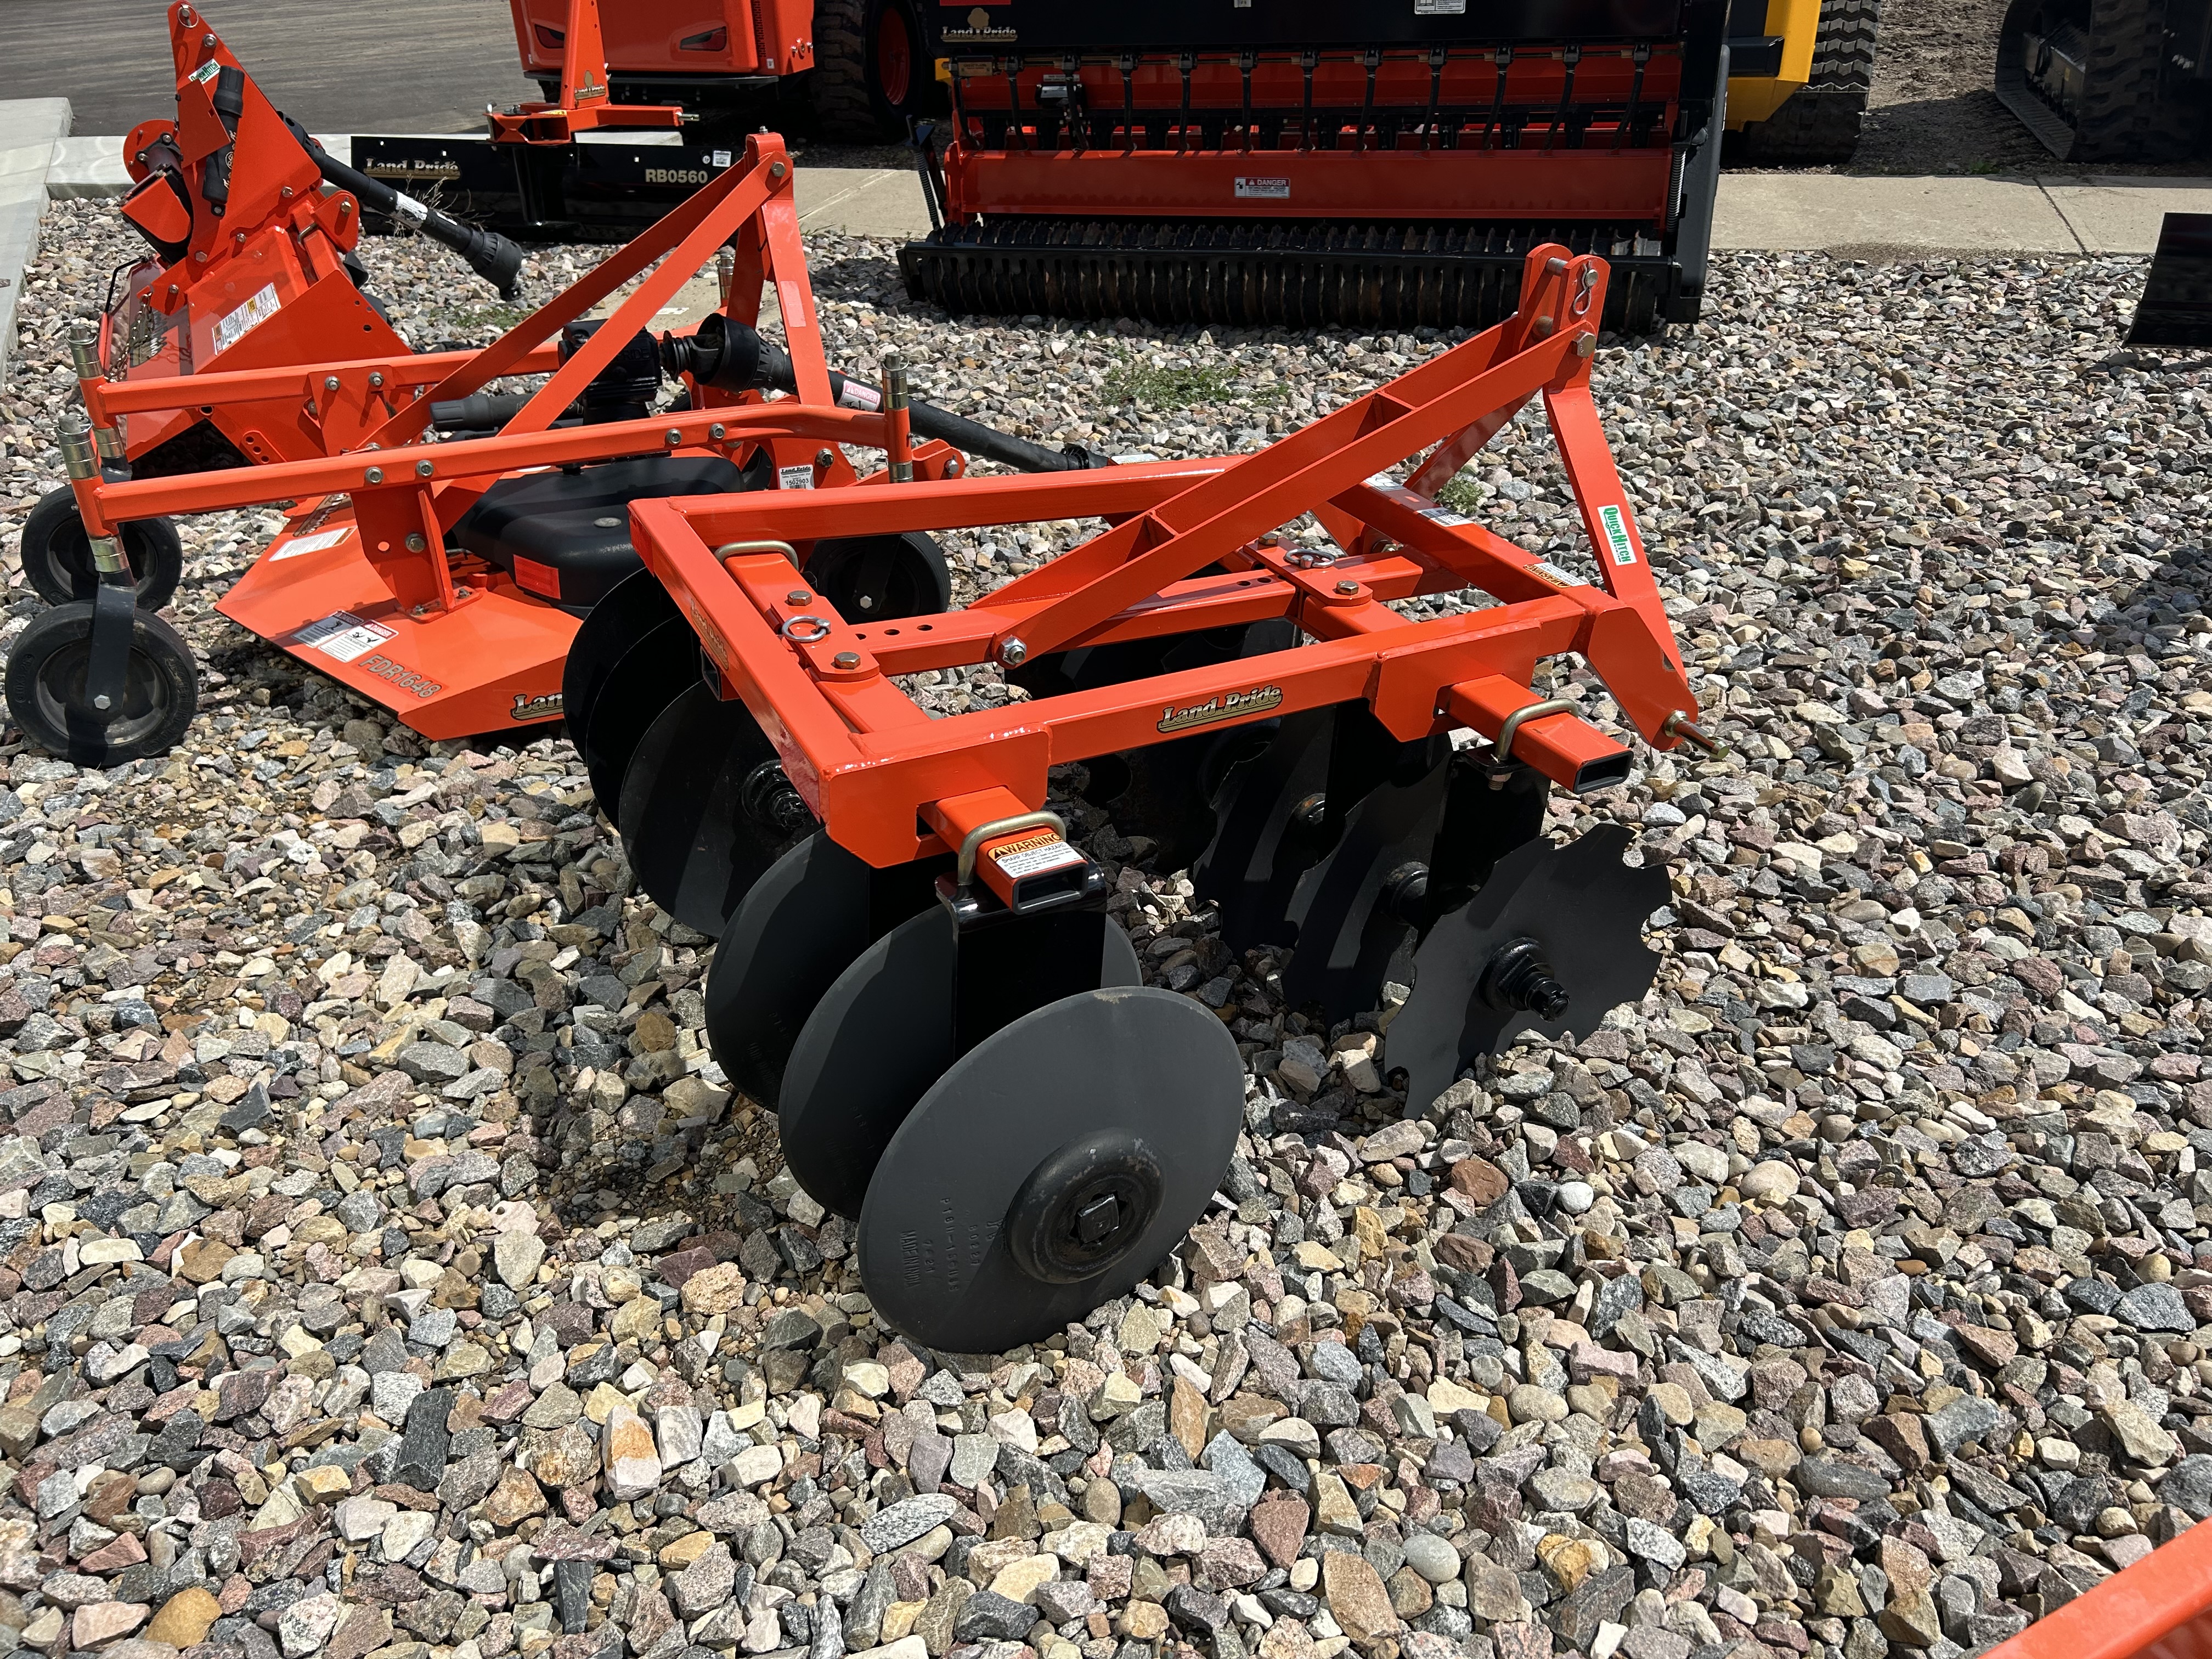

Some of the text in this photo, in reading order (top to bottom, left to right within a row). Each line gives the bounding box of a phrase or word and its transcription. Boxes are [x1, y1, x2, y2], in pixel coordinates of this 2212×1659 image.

[942, 26, 1016, 38] Land Pride
[365, 158, 460, 174] Land Pride
[645, 168, 708, 184] RB0560
[854, 387, 878, 402] DANGER
[785, 478, 809, 486] 1502903
[1604, 507, 1622, 535] QUICK
[1611, 534, 1632, 562] HITCH
[358, 654, 442, 698] FDR1648
[515, 693, 562, 714] Lan
[1161, 685, 1281, 726] Land Pride
[1003, 833, 1062, 853] WARNING
[900, 1230, 921, 1289] MADE IN INDIA
